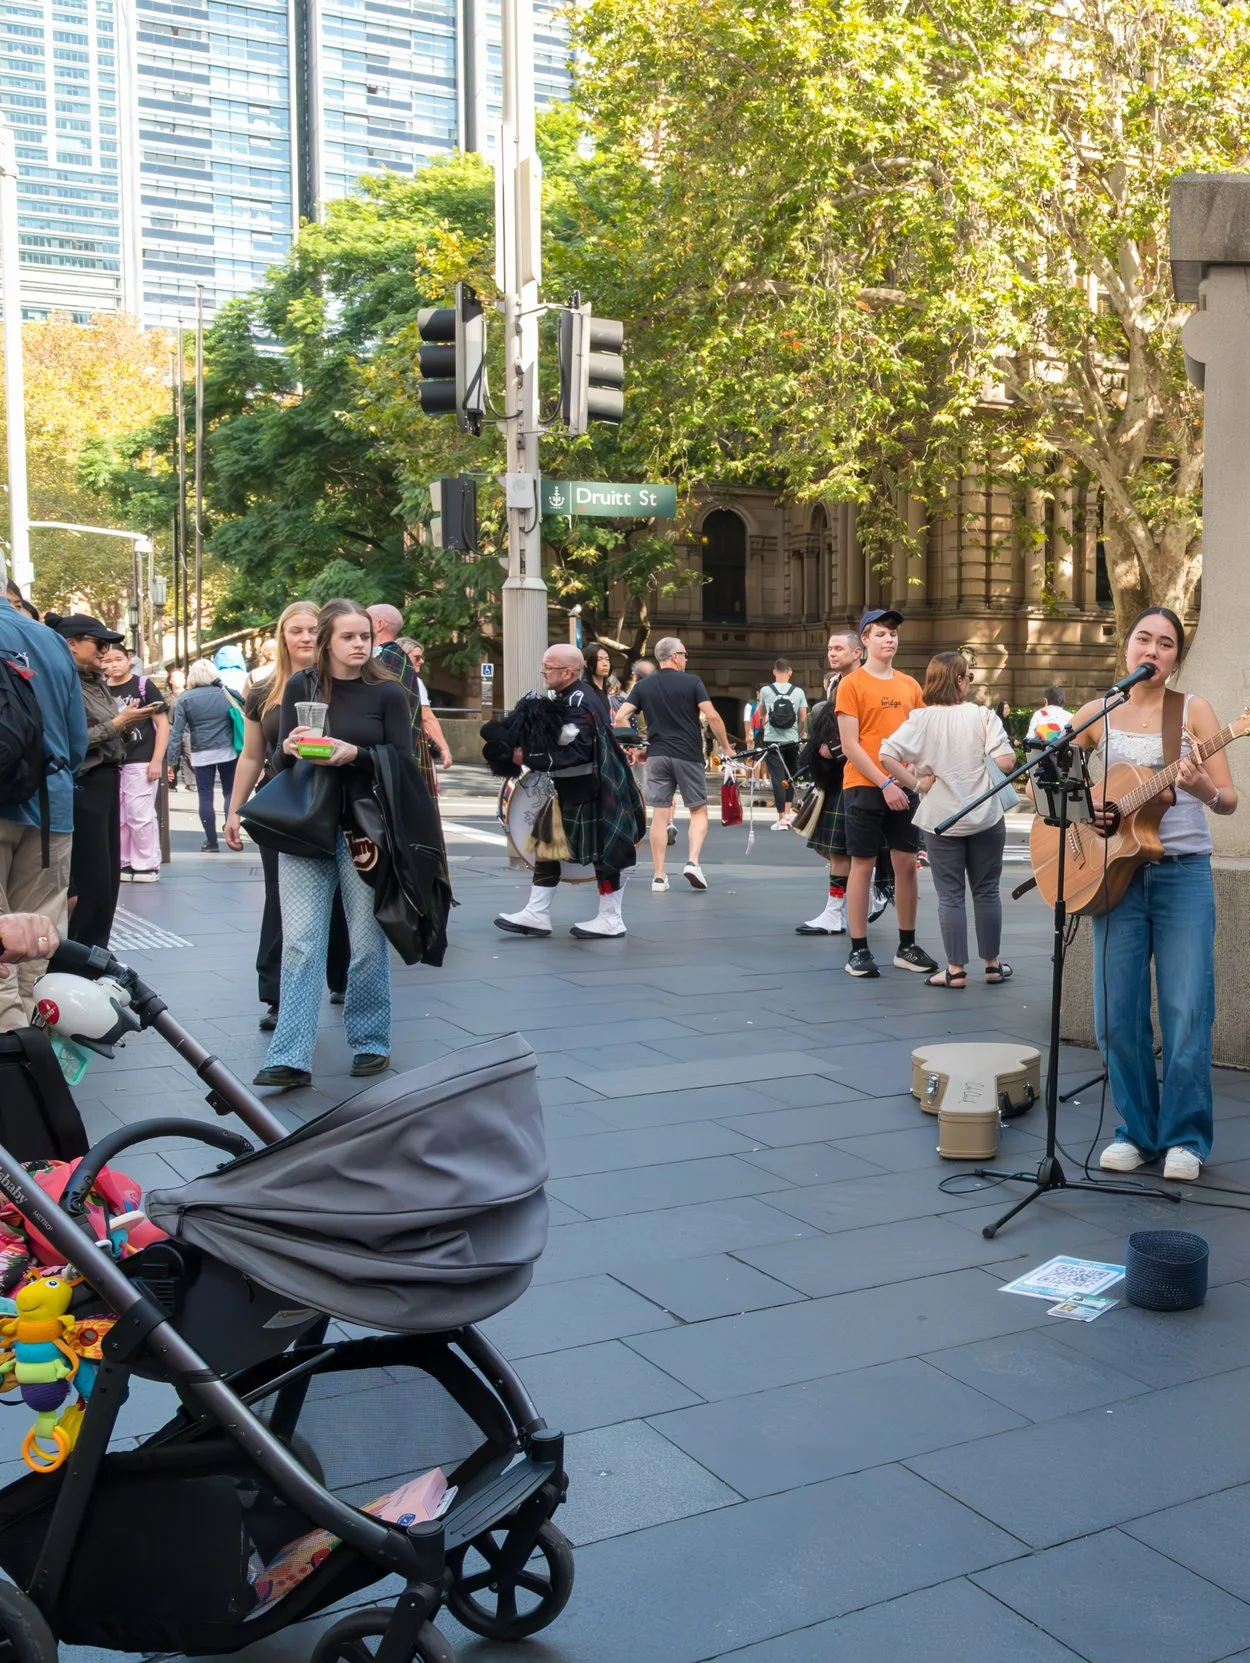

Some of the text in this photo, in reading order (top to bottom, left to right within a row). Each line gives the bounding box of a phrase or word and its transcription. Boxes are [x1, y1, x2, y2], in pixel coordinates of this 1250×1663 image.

[576, 488, 657, 506] Druitt St
[0, 1166, 28, 1204] sbaby
